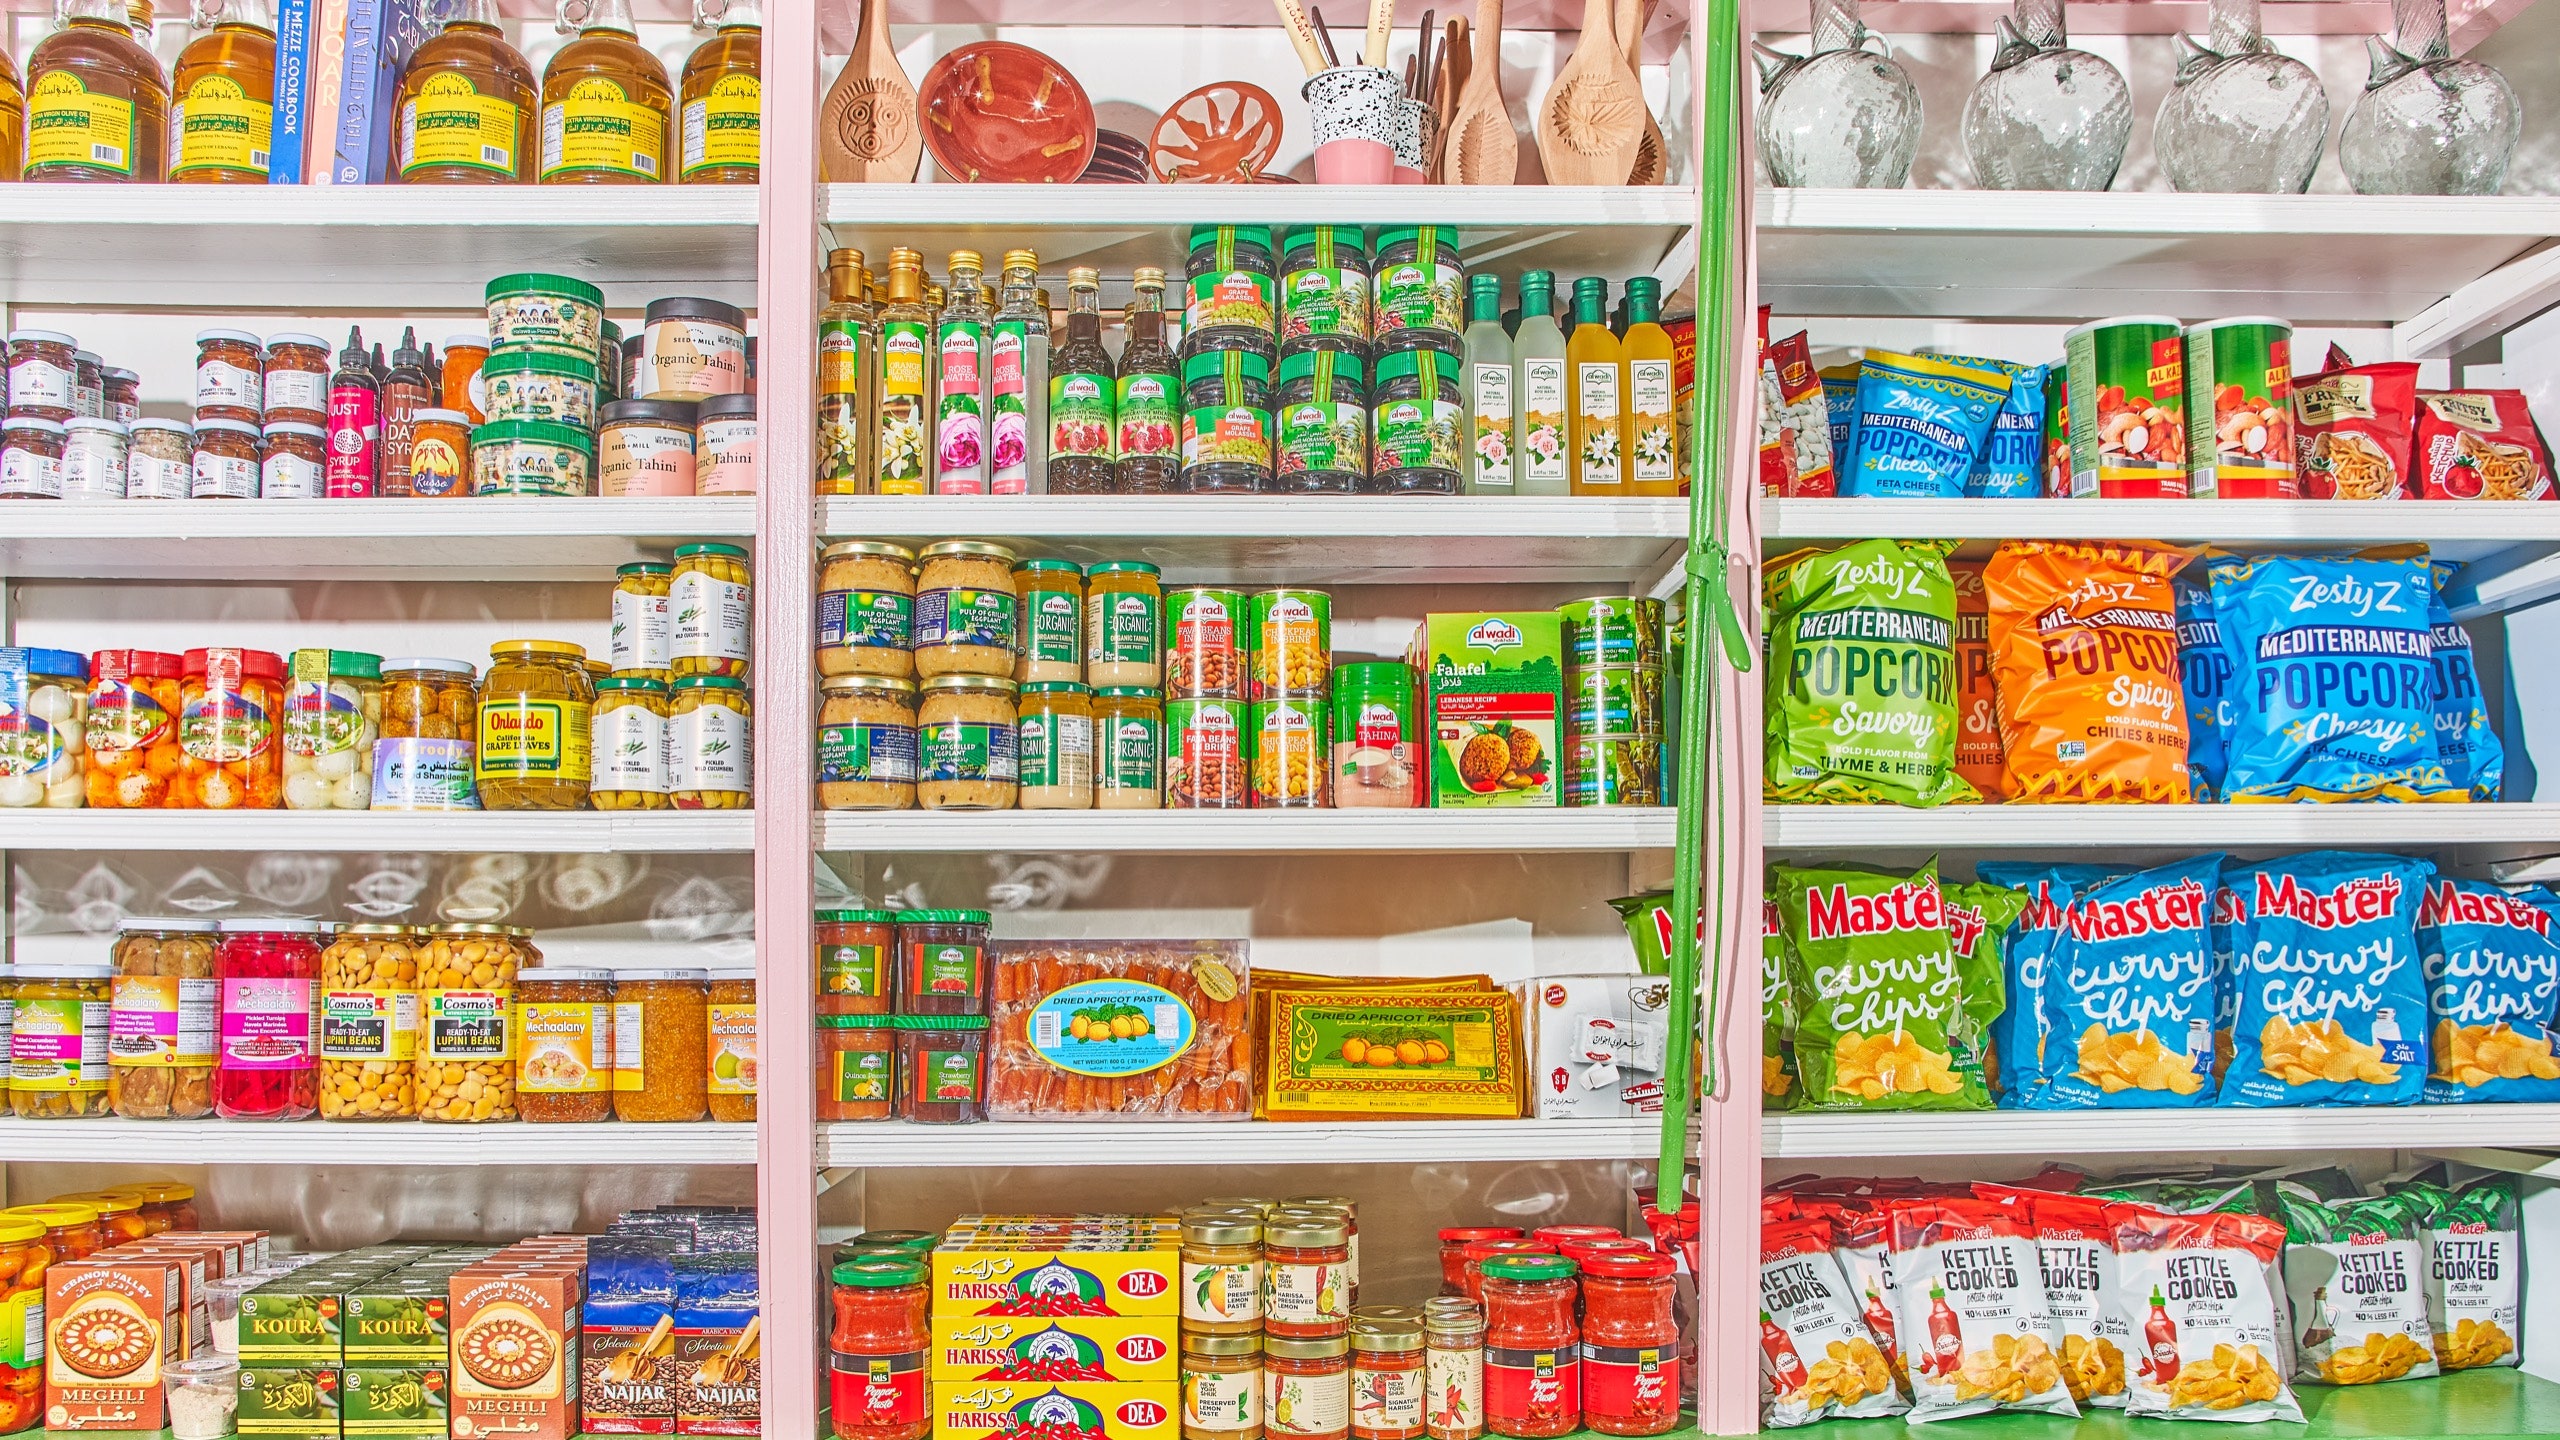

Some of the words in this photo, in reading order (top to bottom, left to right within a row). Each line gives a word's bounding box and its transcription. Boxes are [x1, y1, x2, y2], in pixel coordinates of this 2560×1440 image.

[290, 11, 303, 52] MEZZE
[285, 57, 300, 135] COOKBOOK
[1222, 294, 1254, 302] MOLASSES
[651, 354, 697, 367] Organic
[701, 354, 736, 373] Tahini
[949, 365, 972, 373] ROSE
[996, 365, 1016, 374] ROSE
[945, 373, 976, 382] WATER
[331, 404, 360, 416] JUST
[2439, 399, 2487, 417] FRITSY
[1225, 430, 1256, 438] MOLASSES
[1862, 413, 1965, 450] MEDITERRANEAN
[330, 457, 360, 467] SYRUP
[713, 452, 752, 464] Tahini
[2432, 438, 2454, 482] KETCHUP
[1877, 454, 1942, 480] Cheesy
[416, 474, 448, 488] Russo
[1877, 479, 1898, 488] FETA
[1900, 480, 1940, 492] CHEESE
[1826, 554, 1905, 598] Zesty
[1905, 562, 1932, 598] Z
[2289, 574, 2372, 618] Zesty
[2374, 580, 2404, 613] Z
[971, 616, 1001, 624] EGGPLANT
[988, 611, 1008, 619] GRILLED
[1113, 615, 1149, 632] ORGANIC
[1801, 610, 1948, 647] MEDITERRANEAN
[1133, 634, 1149, 642] TAHINA
[2260, 628, 2431, 659] MEDITERRANEAN
[1437, 663, 1486, 677] Falafel
[1788, 646, 1955, 706] POPCORN
[1437, 678, 1462, 689] فلافل
[2107, 676, 2175, 719] Spicy
[1834, 703, 1935, 748] Savory
[2105, 716, 2126, 725] BOLD
[2127, 717, 2158, 729] FLAVOR
[2159, 721, 2179, 732] FROM
[1359, 731, 1398, 741] TAHINA
[2087, 726, 2143, 742] CHILIES
[2146, 731, 2157, 743] &
[2159, 732, 2188, 751] HERBS
[2306, 713, 2408, 752] Cheesy
[1836, 746, 1861, 755] BOLD
[1863, 747, 1900, 758] FLAVOR
[1902, 750, 1928, 760] FROM
[1821, 756, 1875, 772] THYME
[1879, 760, 1891, 773] &
[1896, 761, 1937, 777] HERBS
[2254, 872, 2402, 930] Master
[1808, 884, 1949, 940] Master
[2068, 890, 2206, 943] Master
[933, 965, 967, 973] Strawberry
[2252, 936, 2407, 986] curvy
[2422, 948, 2557, 1000] curvy
[236, 999, 296, 1011] Mechaalany
[329, 997, 374, 1010] Cosmo's
[442, 998, 494, 1010] Cosmo's
[1053, 996, 1089, 1005] DRIED
[1091, 995, 1131, 1004] APRICOT
[1134, 994, 1166, 1003] PASTE
[1311, 1012, 1355, 1021] DRIED
[1359, 1013, 1424, 1022] APRICOT
[1428, 1014, 1474, 1022] PASTE
[330, 1028, 369, 1036] READY-TO-EAT
[446, 1028, 491, 1036] READY-TO-EAT
[525, 1021, 586, 1033] Mechaalany
[324, 1036, 346, 1045] LUPINI
[349, 1036, 381, 1045] BEANS
[436, 1035, 467, 1046] LUPINI
[470, 1035, 501, 1046] BEANS
[2392, 1050, 2415, 1063] SALT
[939, 1072, 971, 1080] Strawberry
[1953, 1226, 1992, 1242] Master
[2042, 1227, 2083, 1242] Master
[2449, 1221, 2487, 1235] Master
[2180, 1235, 2214, 1250] Master
[2350, 1231, 2387, 1247] Master
[1761, 1246, 1797, 1264] Master
[1941, 1246, 2014, 1270] KETTLE
[2433, 1240, 2500, 1260] KETTLE
[2167, 1256, 2230, 1278] KETTLE
[2339, 1251, 2405, 1273] KETTLE
[1760, 1261, 1818, 1293] KETTLE
[2432, 1260, 2499, 1281] COOKED
[56, 1271, 110, 1297] LEBANON
[113, 1271, 153, 1299] VALLEY
[1128, 1274, 1157, 1293] DEA
[1946, 1268, 2018, 1291] COOKED
[2342, 1271, 2407, 1294] COOKED
[459, 1281, 509, 1308] LEBANON
[511, 1282, 551, 1310] VALLEY
[948, 1283, 1020, 1299] HARISSA
[1766, 1281, 1831, 1312] COOKED
[2168, 1279, 2238, 1300] COOKED
[253, 1319, 326, 1334] KOURA
[359, 1320, 433, 1335] KOURA
[593, 1336, 641, 1351] Selection
[685, 1339, 733, 1354] Selection
[1127, 1340, 1156, 1360] DEA
[946, 1348, 1018, 1365] HARISSA
[1530, 1379, 1560, 1392] Pepper
[1634, 1375, 1664, 1388] Pepper
[62, 1389, 145, 1401] MEGHLI
[603, 1385, 666, 1403] NAJJAR
[696, 1387, 758, 1406] NAJJAR
[864, 1387, 896, 1401] Pepper
[1532, 1391, 1558, 1402] Paste
[1637, 1386, 1662, 1398] Paste
[467, 1400, 547, 1413] MEGHLI
[868, 1398, 894, 1410] Paste
[1388, 1397, 1419, 1405] SIGNATURE
[68, 1405, 137, 1428] مغلي
[948, 1412, 1019, 1428] HARISSA
[1127, 1404, 1156, 1424] DEA
[474, 1416, 540, 1438] مغلي
